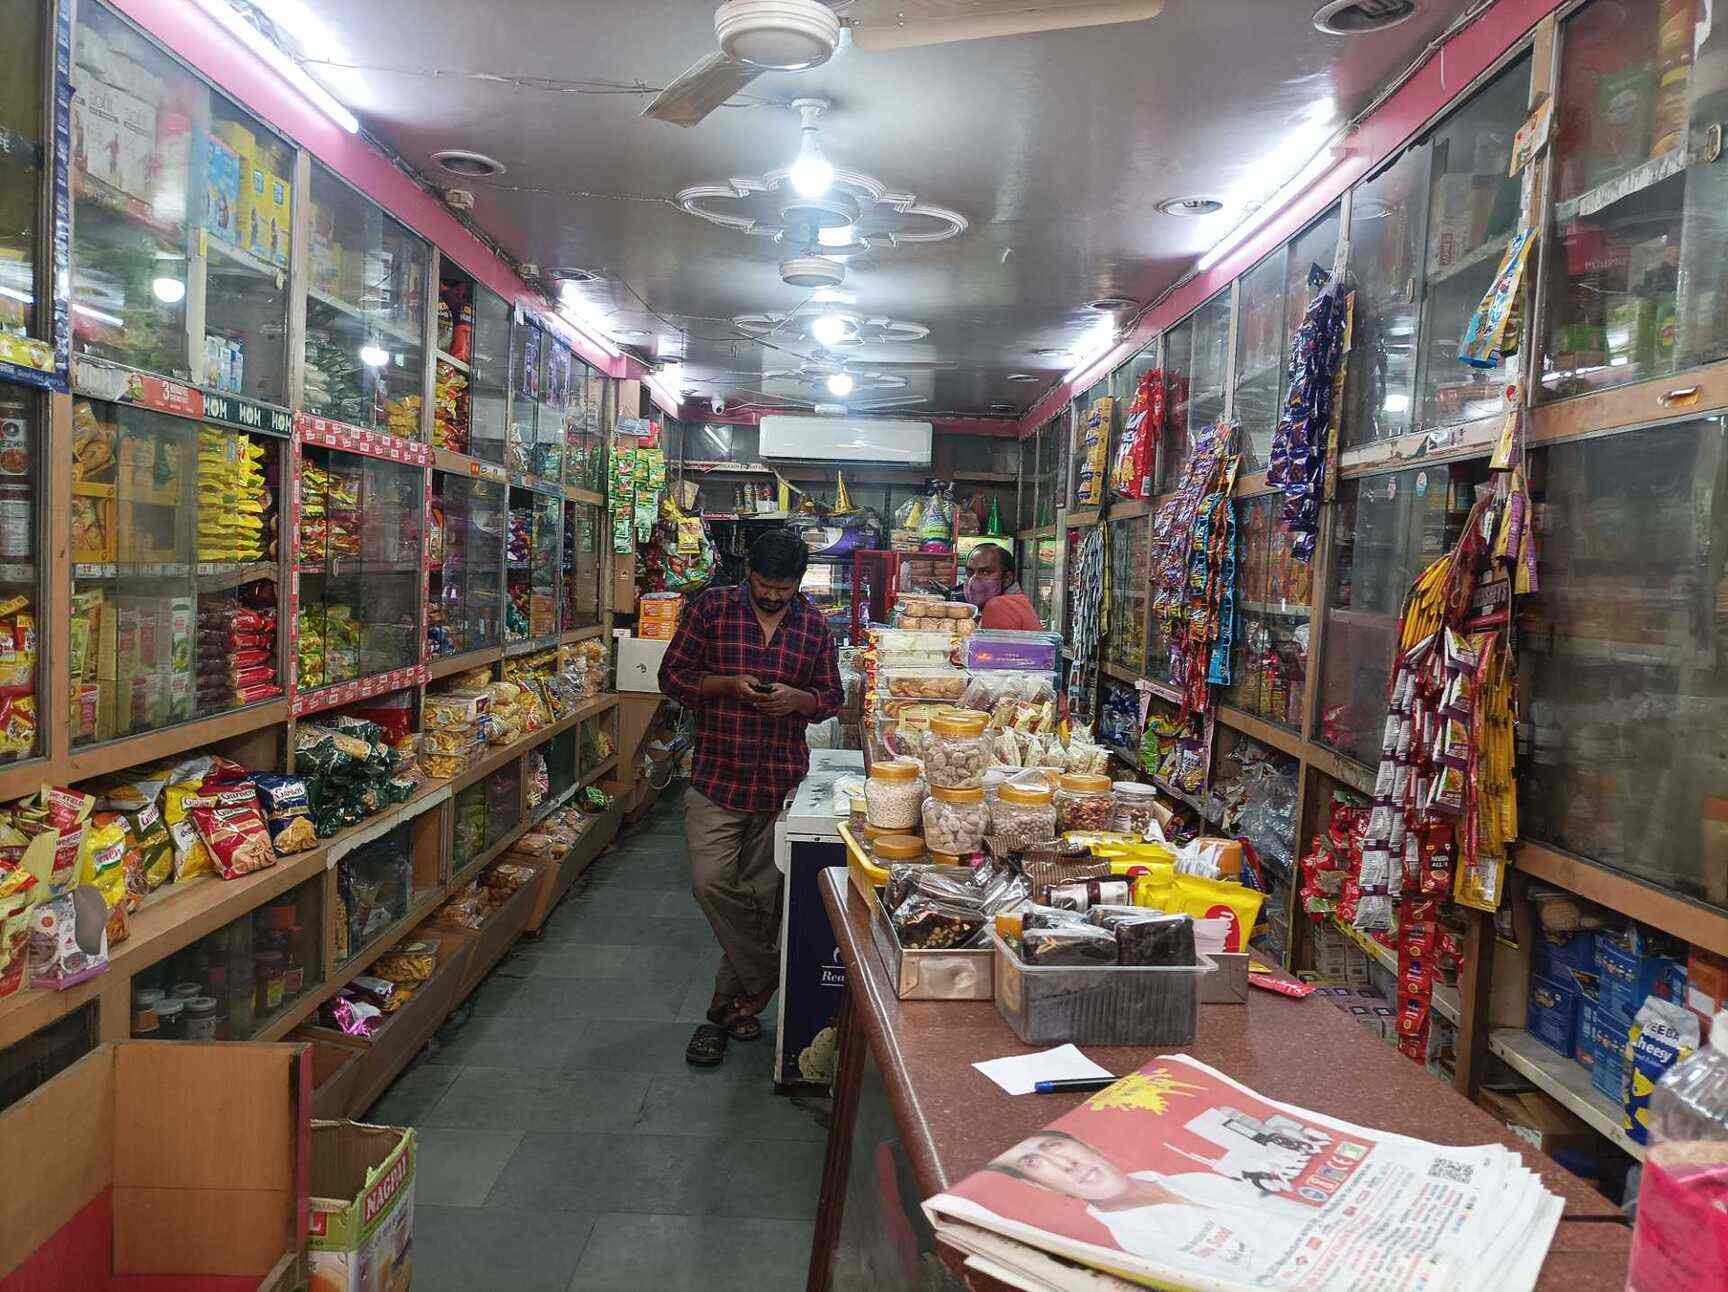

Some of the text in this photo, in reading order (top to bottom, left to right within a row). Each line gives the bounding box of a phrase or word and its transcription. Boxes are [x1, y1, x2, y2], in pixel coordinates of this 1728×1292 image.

[205, 398, 228, 420] MOM
[239, 405, 261, 427] MOM
[1637, 1040, 1673, 1063] heesy
